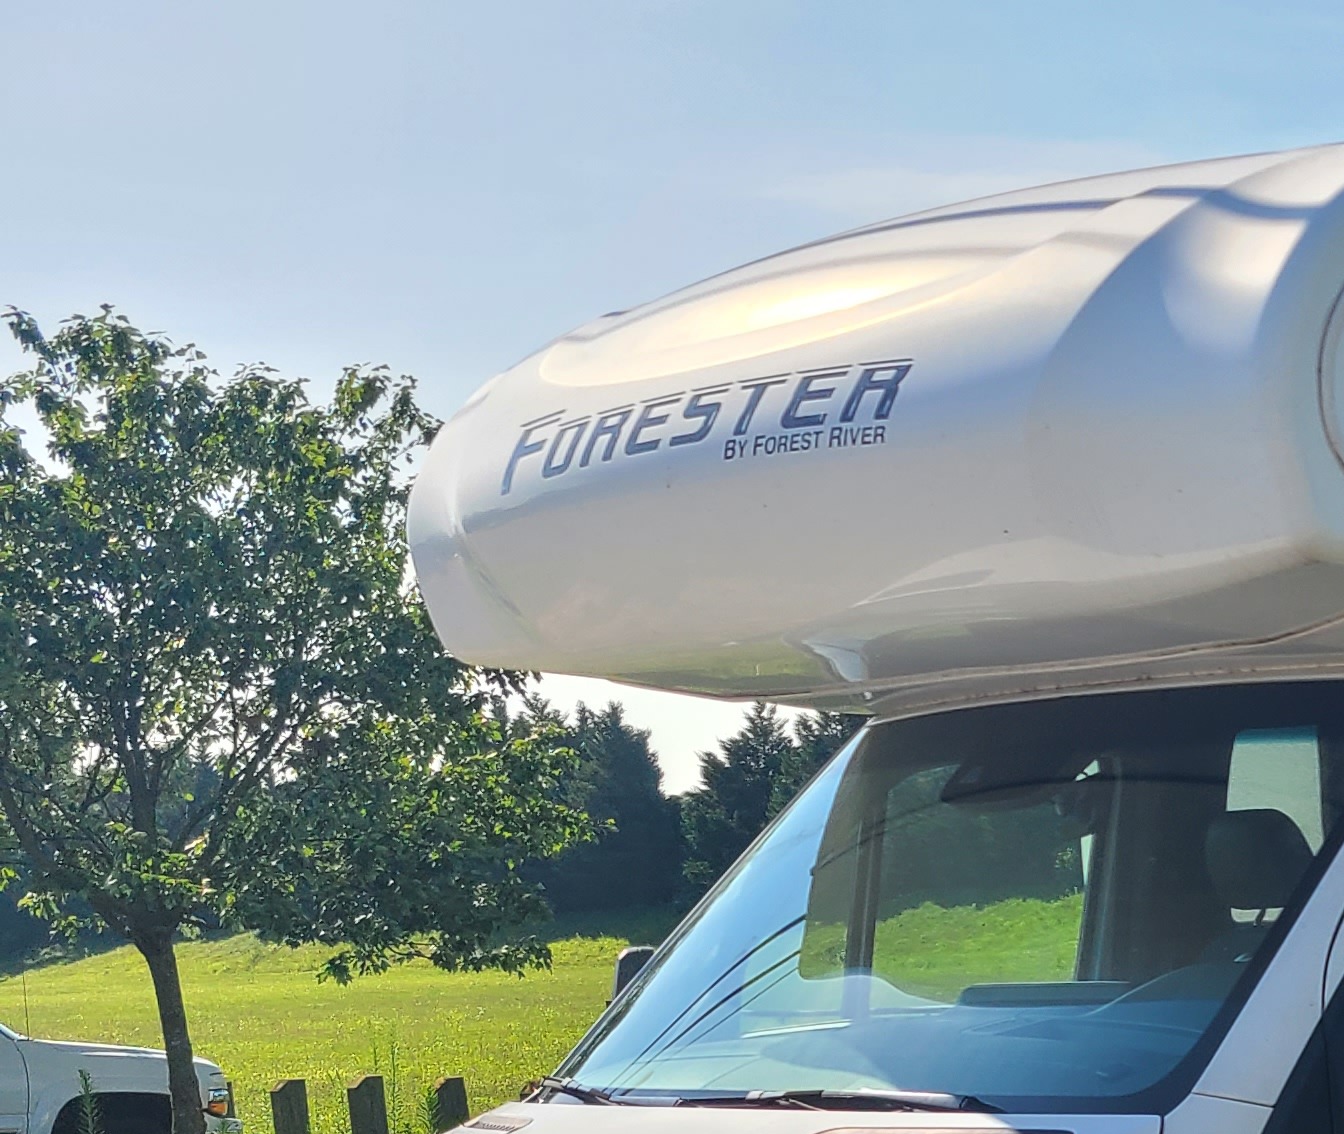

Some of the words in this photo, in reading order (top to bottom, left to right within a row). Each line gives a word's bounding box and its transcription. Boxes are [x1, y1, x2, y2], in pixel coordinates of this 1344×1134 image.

[501, 358, 914, 496] FORESTER
[723, 439, 748, 460] BY
[752, 430, 824, 456] FOREST
[828, 425, 887, 448] RIVER
